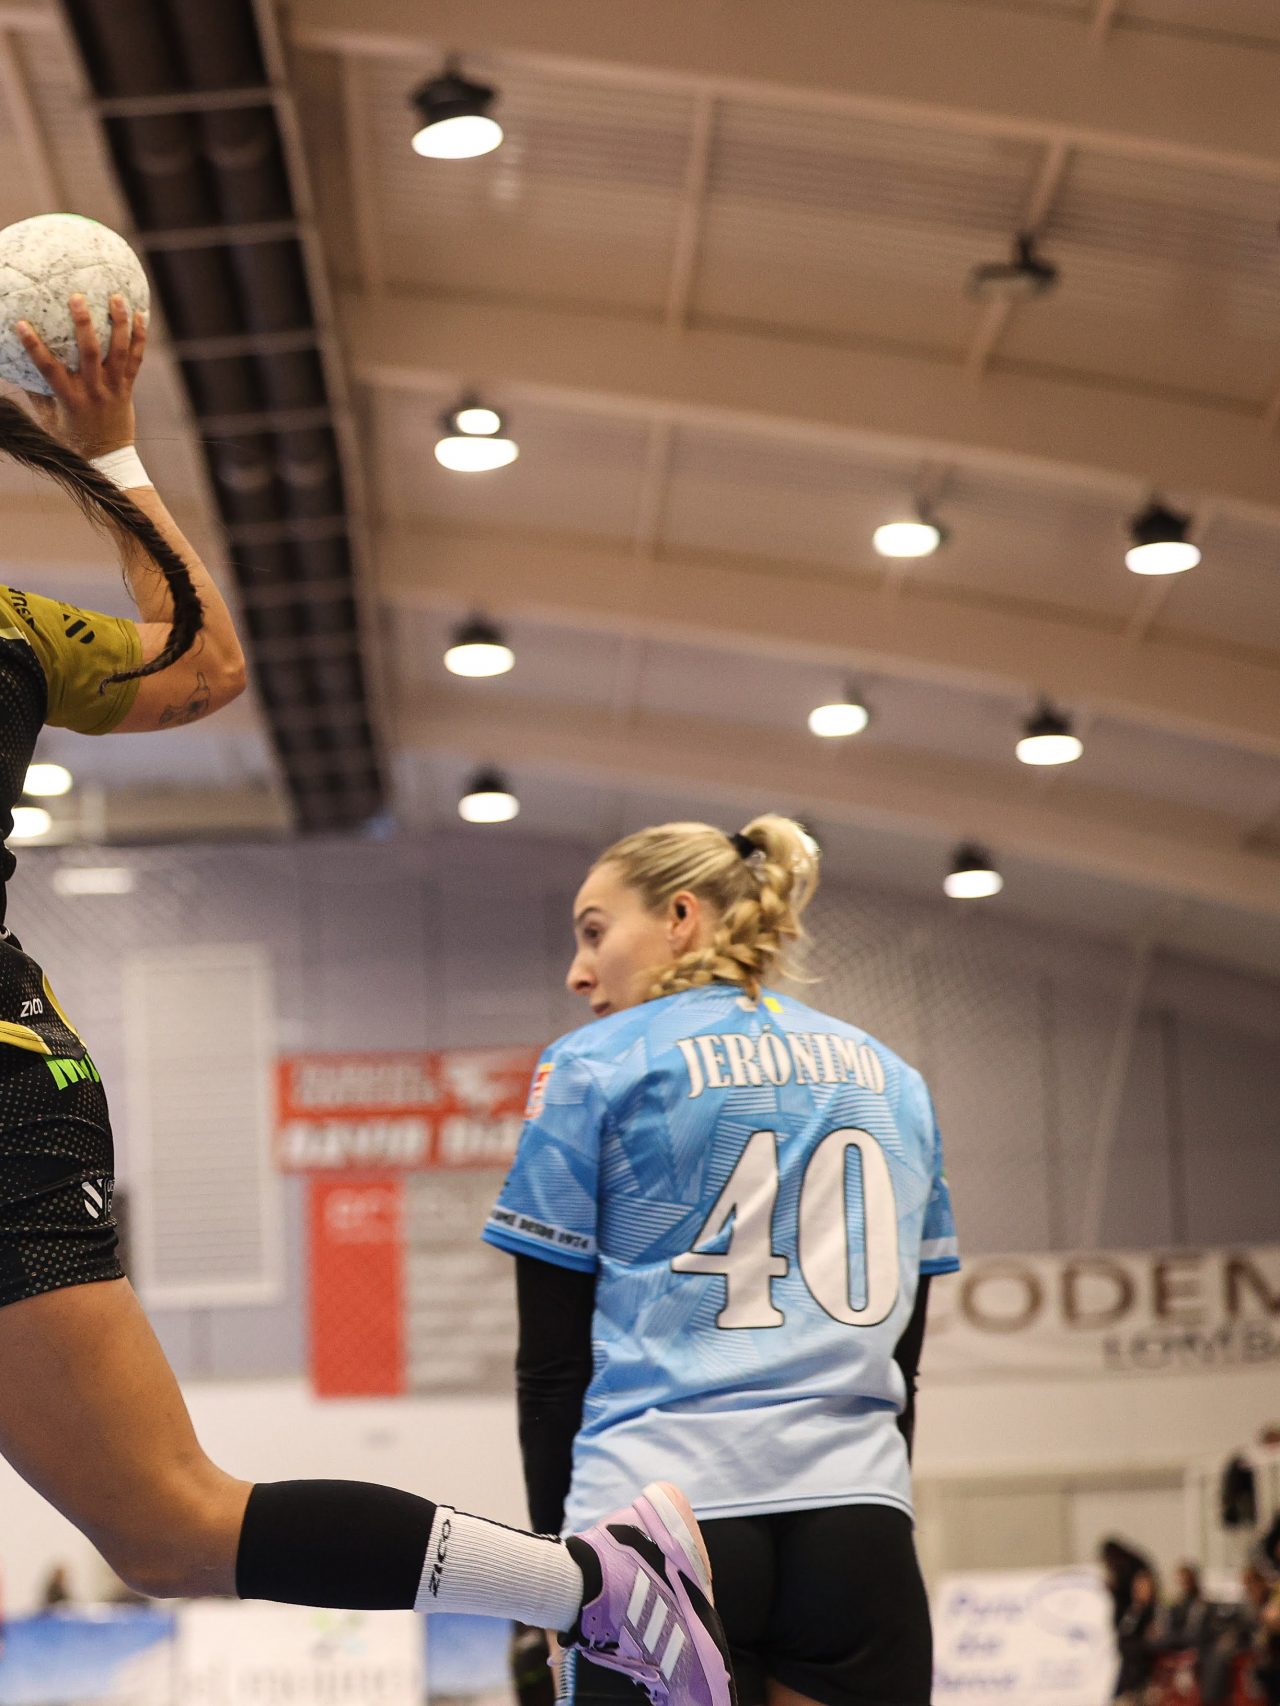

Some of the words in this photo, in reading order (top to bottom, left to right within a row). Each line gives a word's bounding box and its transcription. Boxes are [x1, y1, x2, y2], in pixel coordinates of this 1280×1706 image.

[20, 998, 44, 1018] ZICO
[676, 1023, 886, 1100] JERÓNIMO
[671, 1127, 900, 1330] 40
[427, 1519, 451, 1598] ZICO
